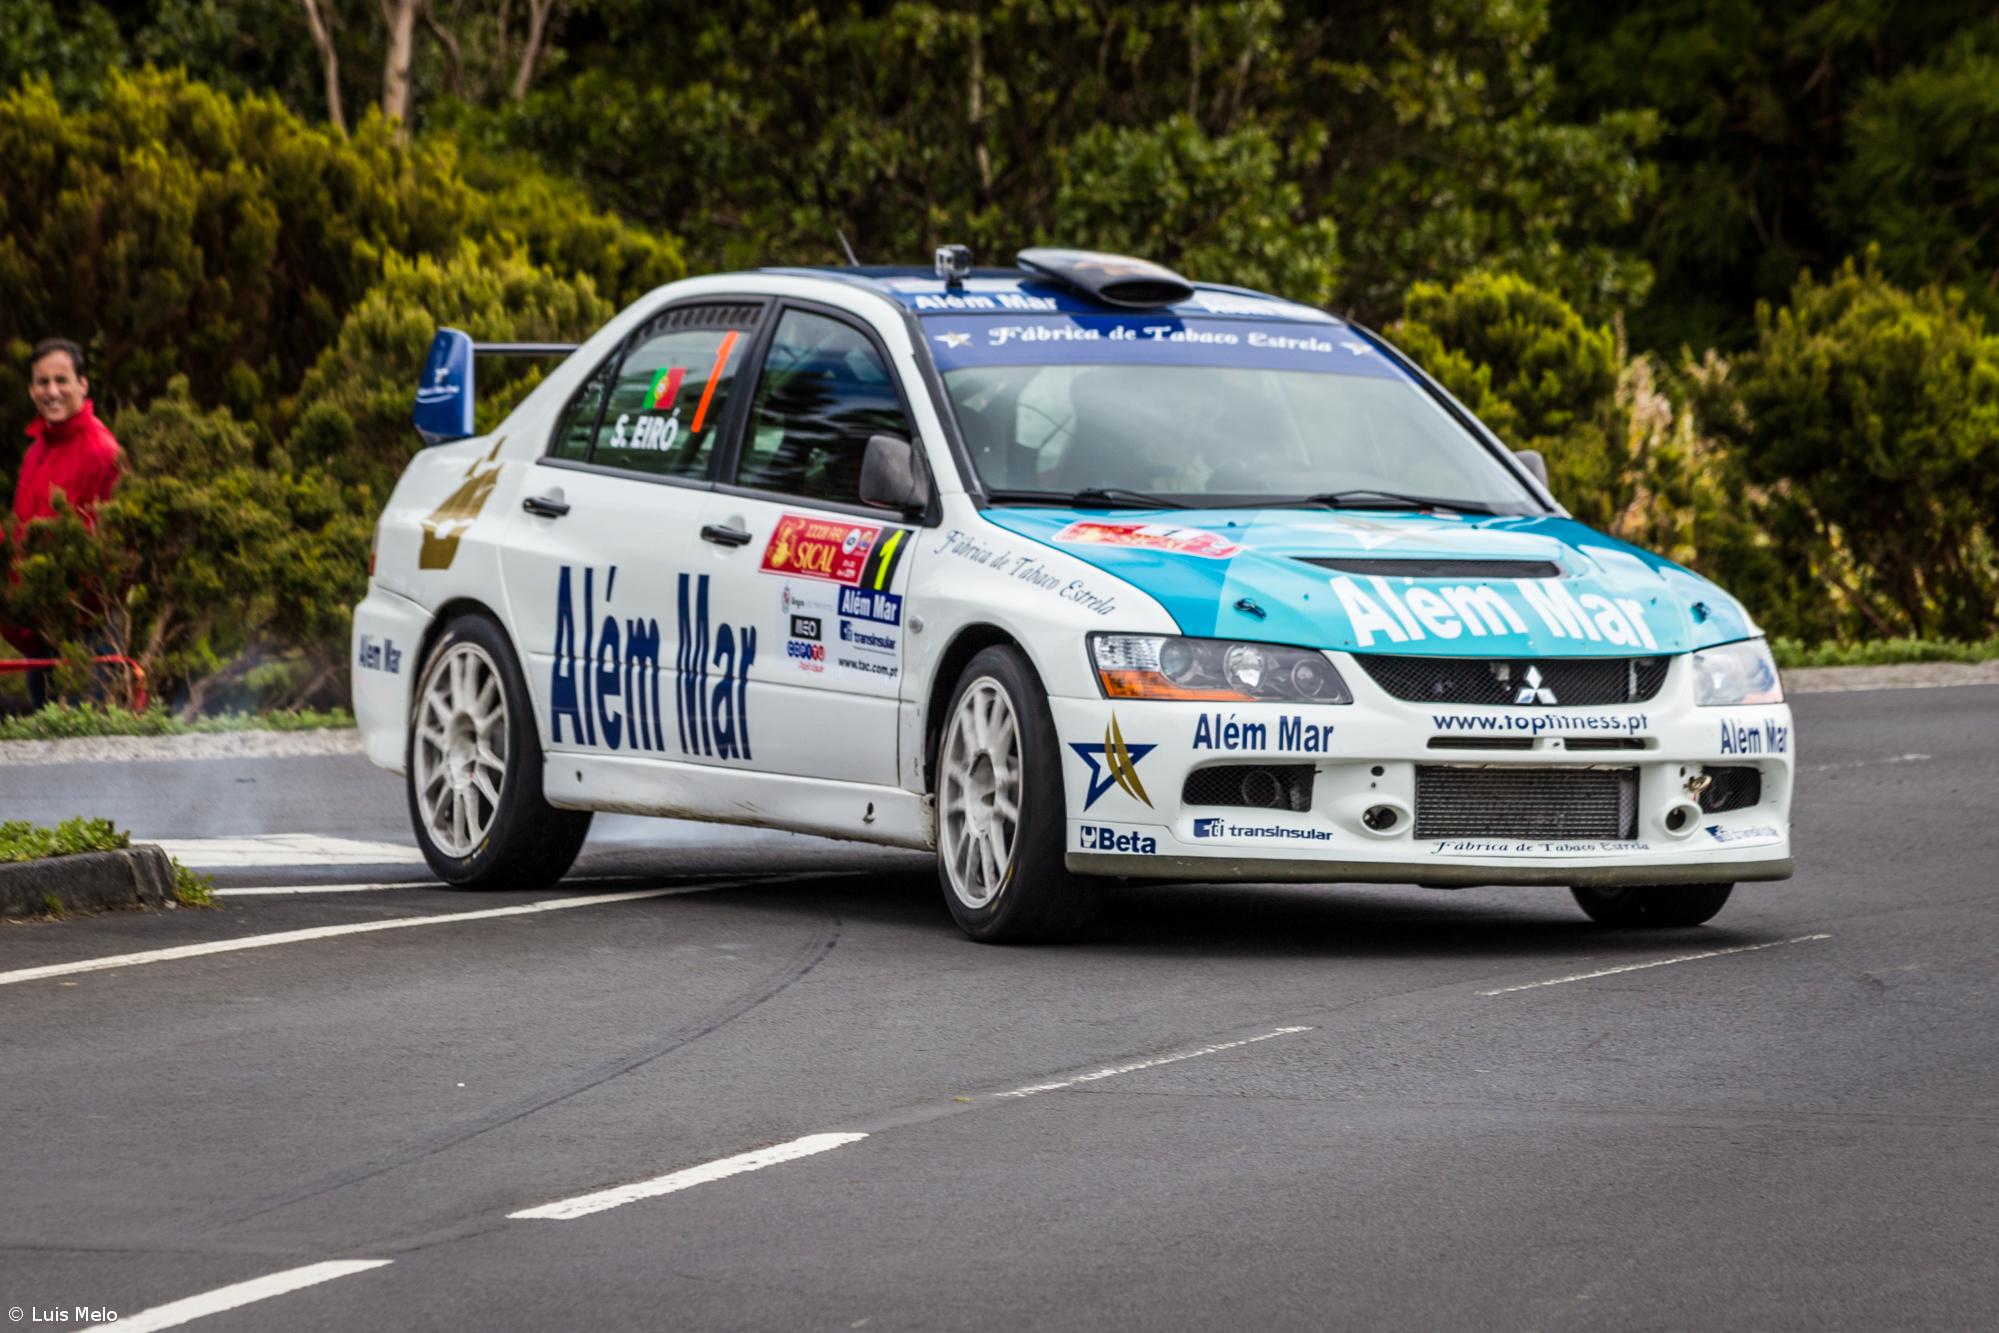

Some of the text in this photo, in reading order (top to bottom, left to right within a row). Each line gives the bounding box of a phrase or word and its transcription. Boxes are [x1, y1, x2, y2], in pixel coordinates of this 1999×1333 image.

[996, 294, 1058, 310] Mar
[988, 325, 1333, 352] Fábrica de Tabaco Estrela
[609, 407, 681, 451] S. EIRÓ
[793, 541, 836, 573] SICAL
[874, 529, 905, 590] 1
[934, 529, 1116, 616] Fábrica de Tabaco Estrela
[842, 588, 871, 617] Além
[872, 594, 898, 621] Mar
[1511, 577, 1658, 651] Mar
[358, 633, 402, 674] Além Mar
[551, 565, 757, 760] Além Mar
[1192, 713, 1334, 753] Além Mar
[1433, 713, 1648, 735] www.topfitness.pt
[1764, 718, 1787, 754] Mar
[1099, 828, 1157, 854] Beta
[1228, 825, 1333, 841] transinsular
[1431, 841, 1508, 854] Fábrica
[1516, 843, 1533, 852] de
[1537, 842, 1596, 852] Tabaco
